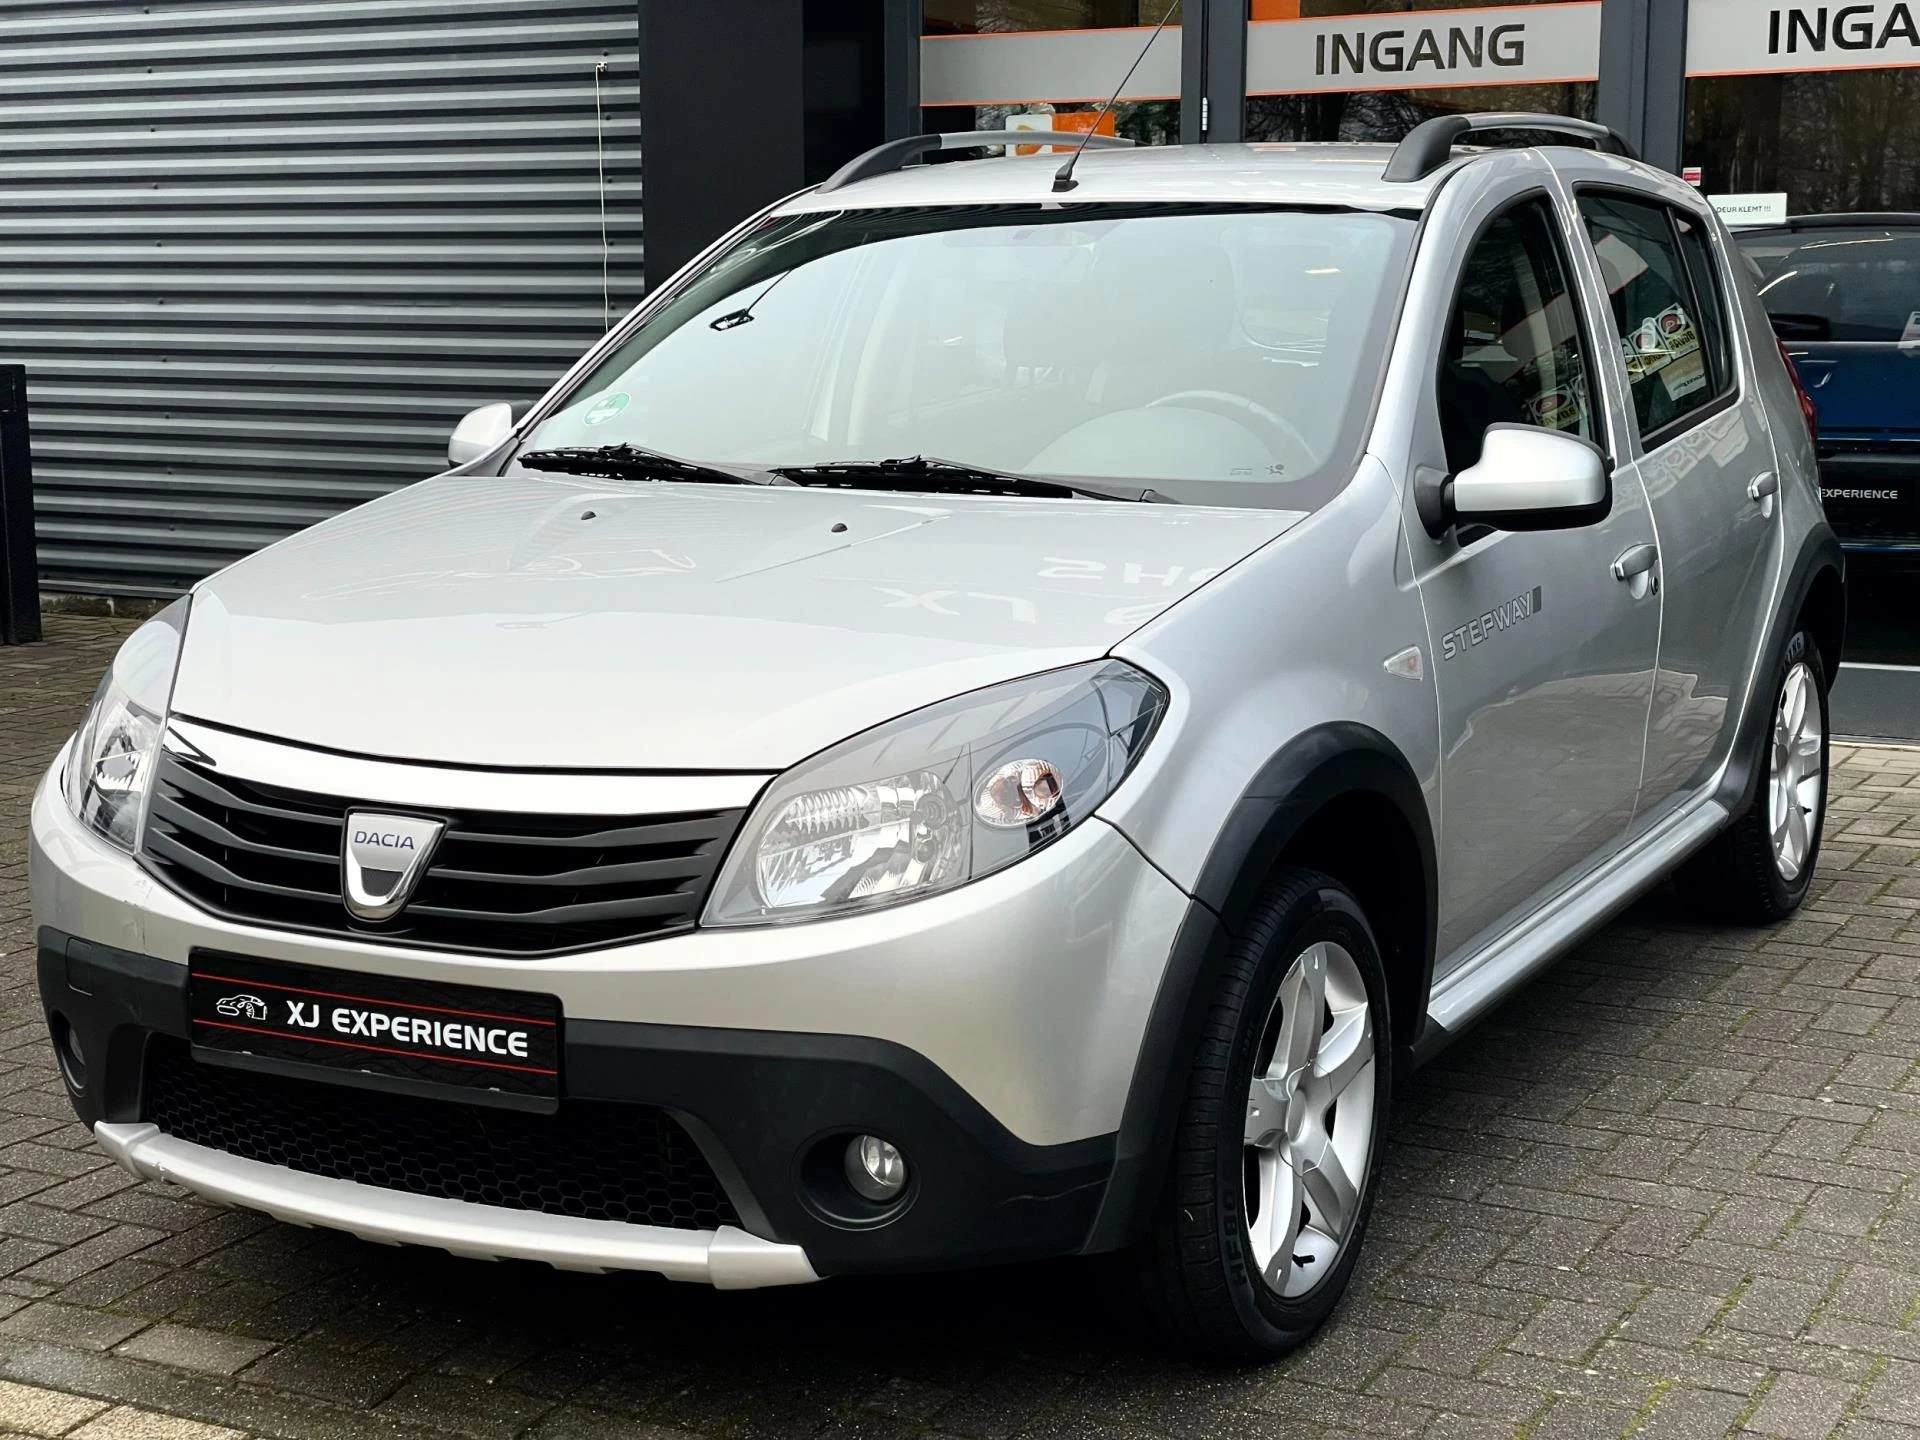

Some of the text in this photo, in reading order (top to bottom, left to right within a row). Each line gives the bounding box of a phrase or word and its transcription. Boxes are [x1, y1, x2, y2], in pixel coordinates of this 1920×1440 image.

[1315, 24, 1525, 75] INGANG
[1768, 3, 1920, 54] INGA
[1442, 591, 1531, 661] STEPWAY
[354, 831, 414, 850] DACIA
[286, 1000, 528, 1057] XJ EXPERIENCE
